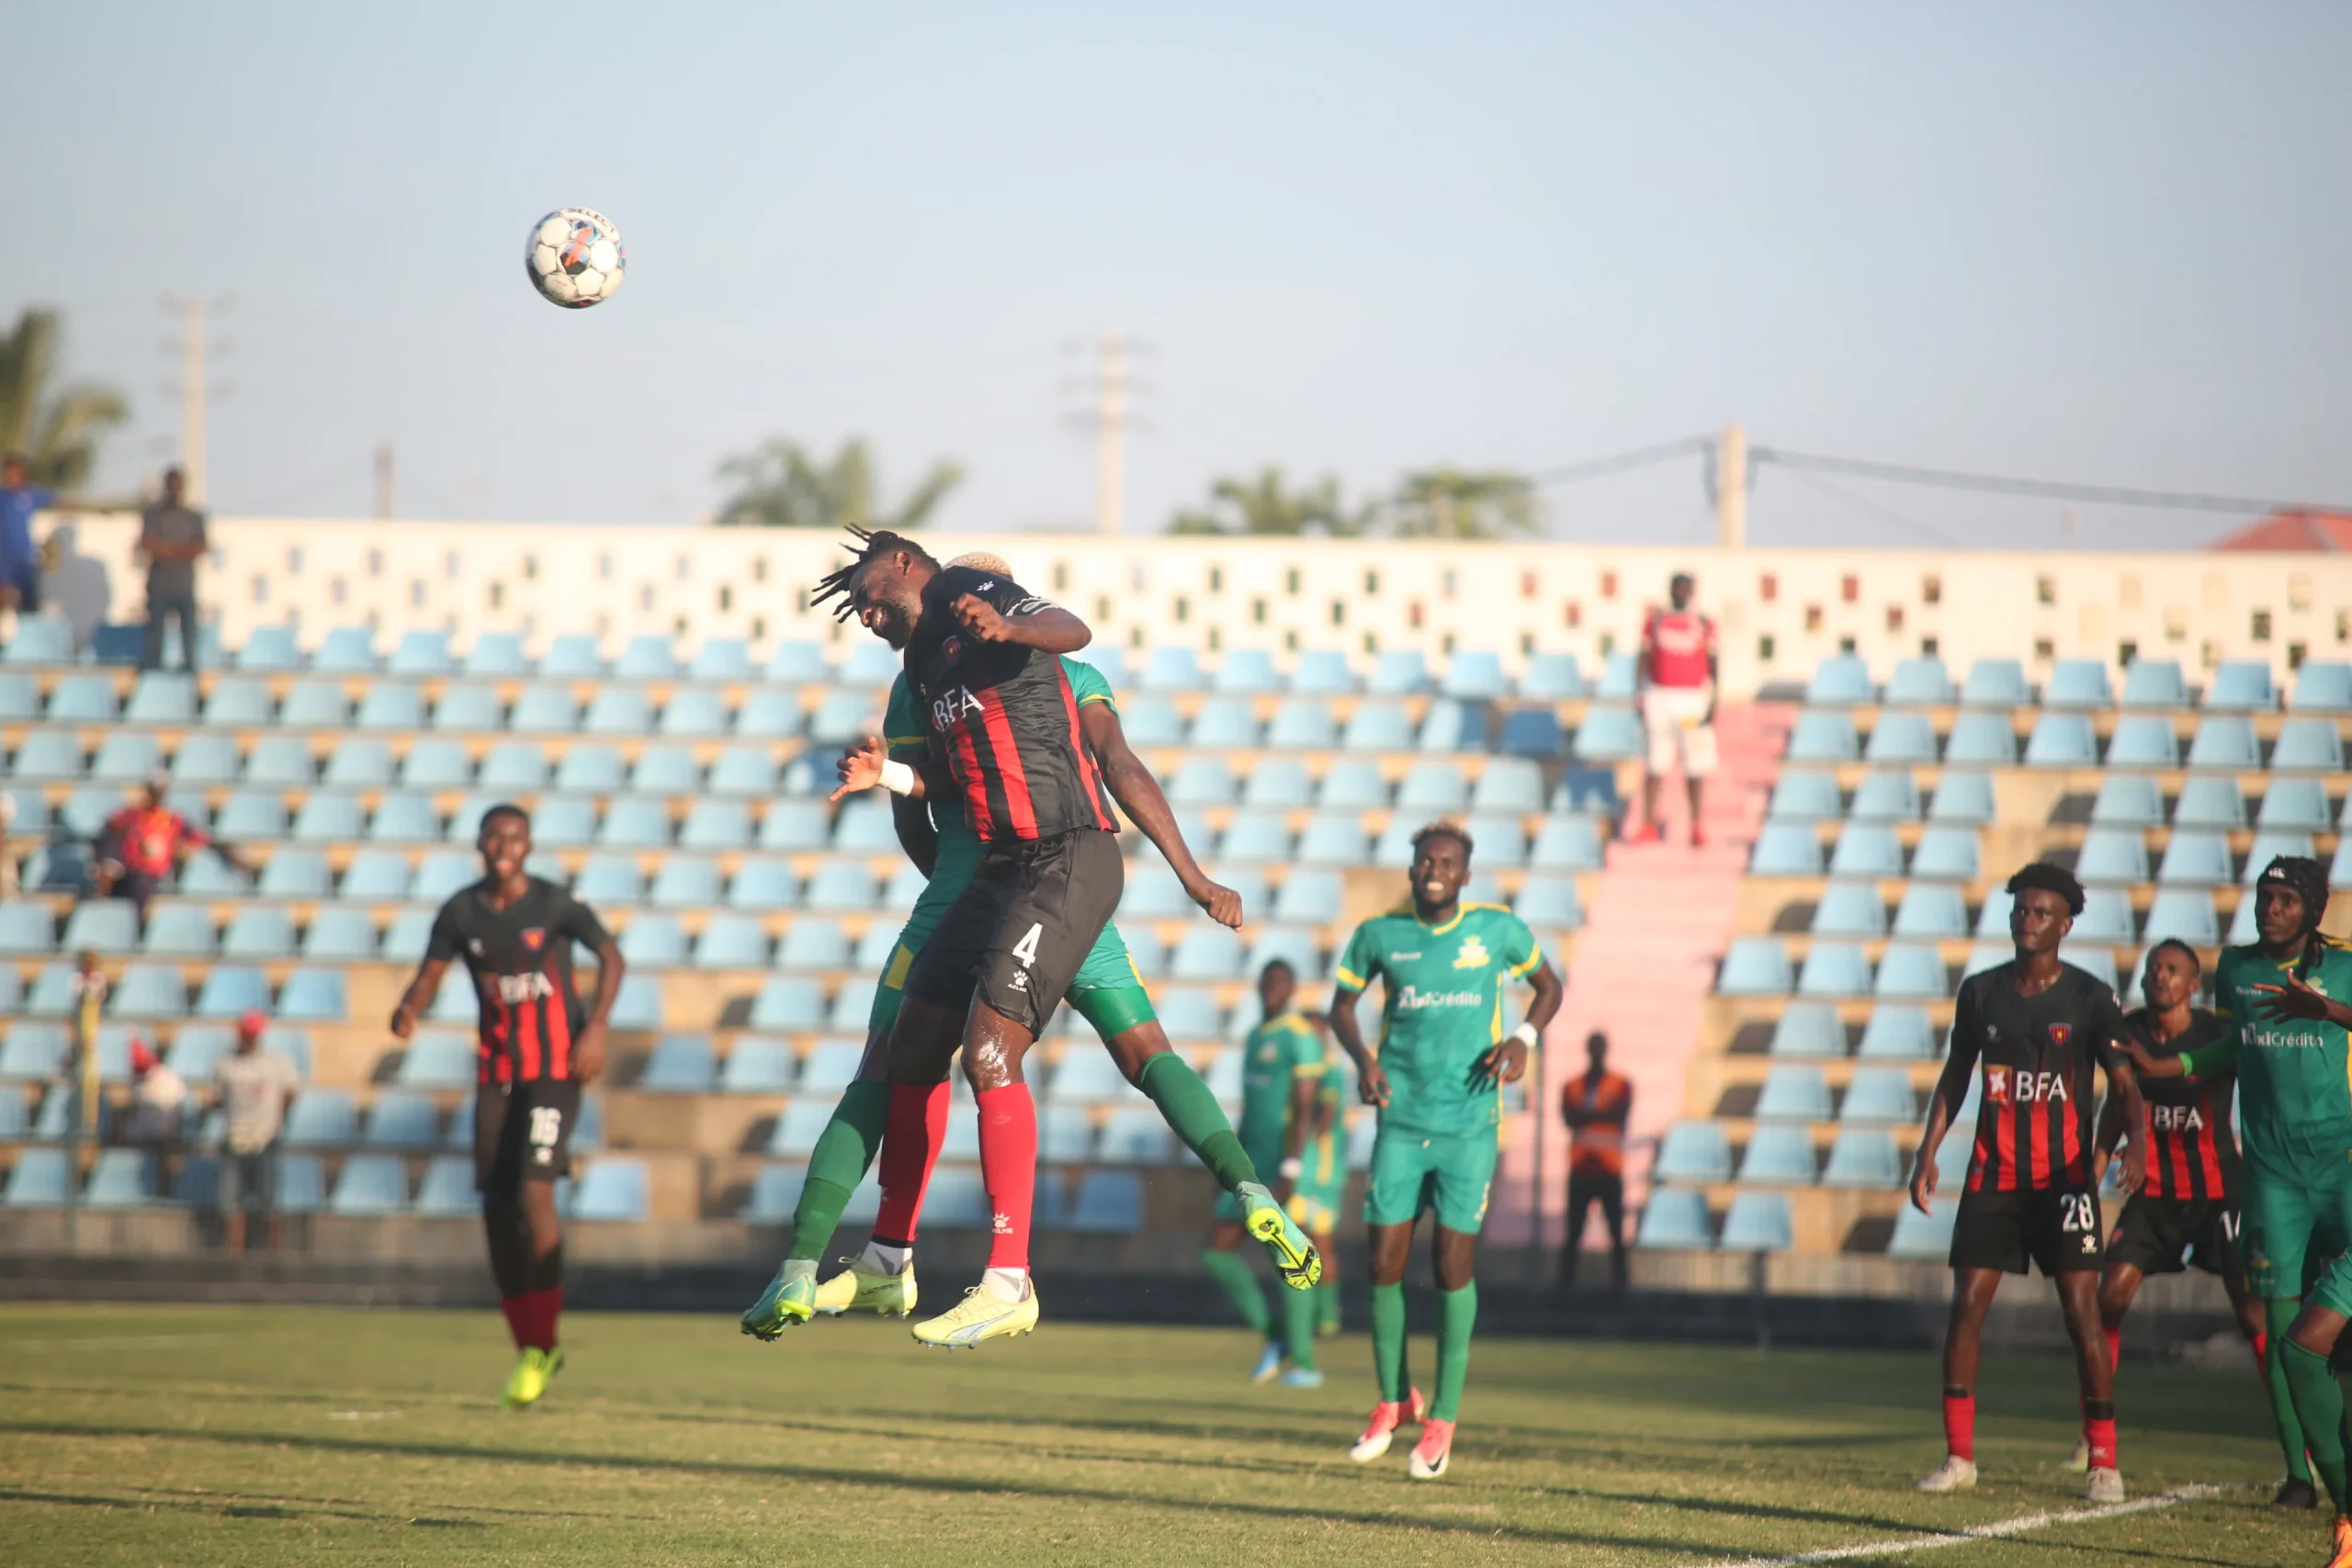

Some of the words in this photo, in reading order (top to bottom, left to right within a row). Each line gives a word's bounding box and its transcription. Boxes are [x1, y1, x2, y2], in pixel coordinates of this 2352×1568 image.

[933, 684, 986, 732] BFA
[1012, 922, 1043, 968] 4
[2016, 1070, 2068, 1102] BFA
[2154, 1105, 2203, 1133] BFA
[2060, 1193, 2094, 1232] 28
